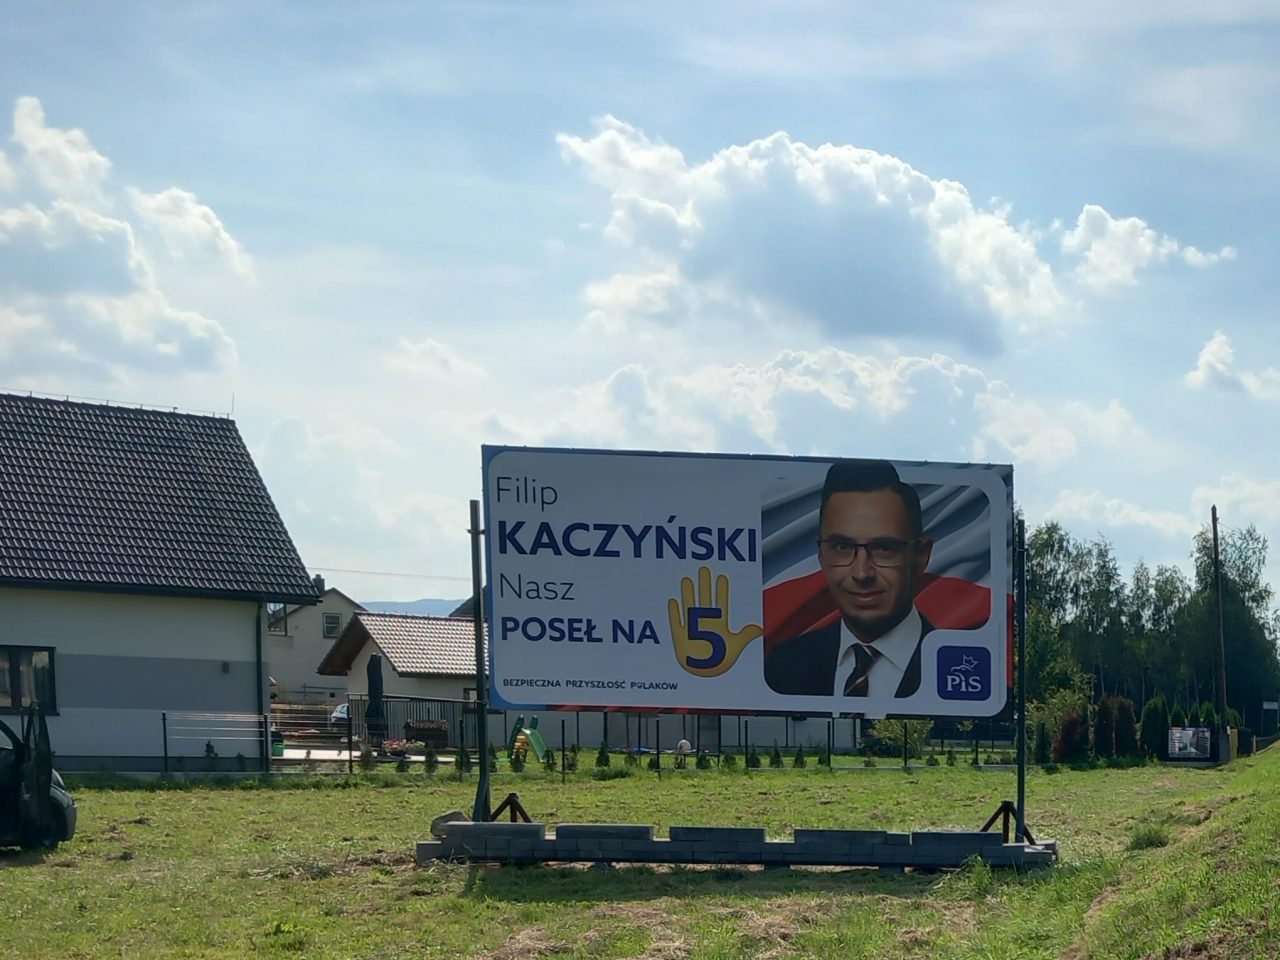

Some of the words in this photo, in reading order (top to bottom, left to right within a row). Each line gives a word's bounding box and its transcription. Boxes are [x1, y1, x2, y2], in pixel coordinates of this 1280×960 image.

[496, 476, 558, 512] Filip
[498, 515, 757, 562] KACZYŃSKI
[499, 572, 575, 600] Nasz
[501, 616, 603, 643] POSEŁ
[612, 619, 660, 645] NA
[685, 606, 727, 670] 5
[503, 678, 561, 688] BEZPIECZNA
[565, 679, 626, 690] PRZYSZŁOŚĆ
